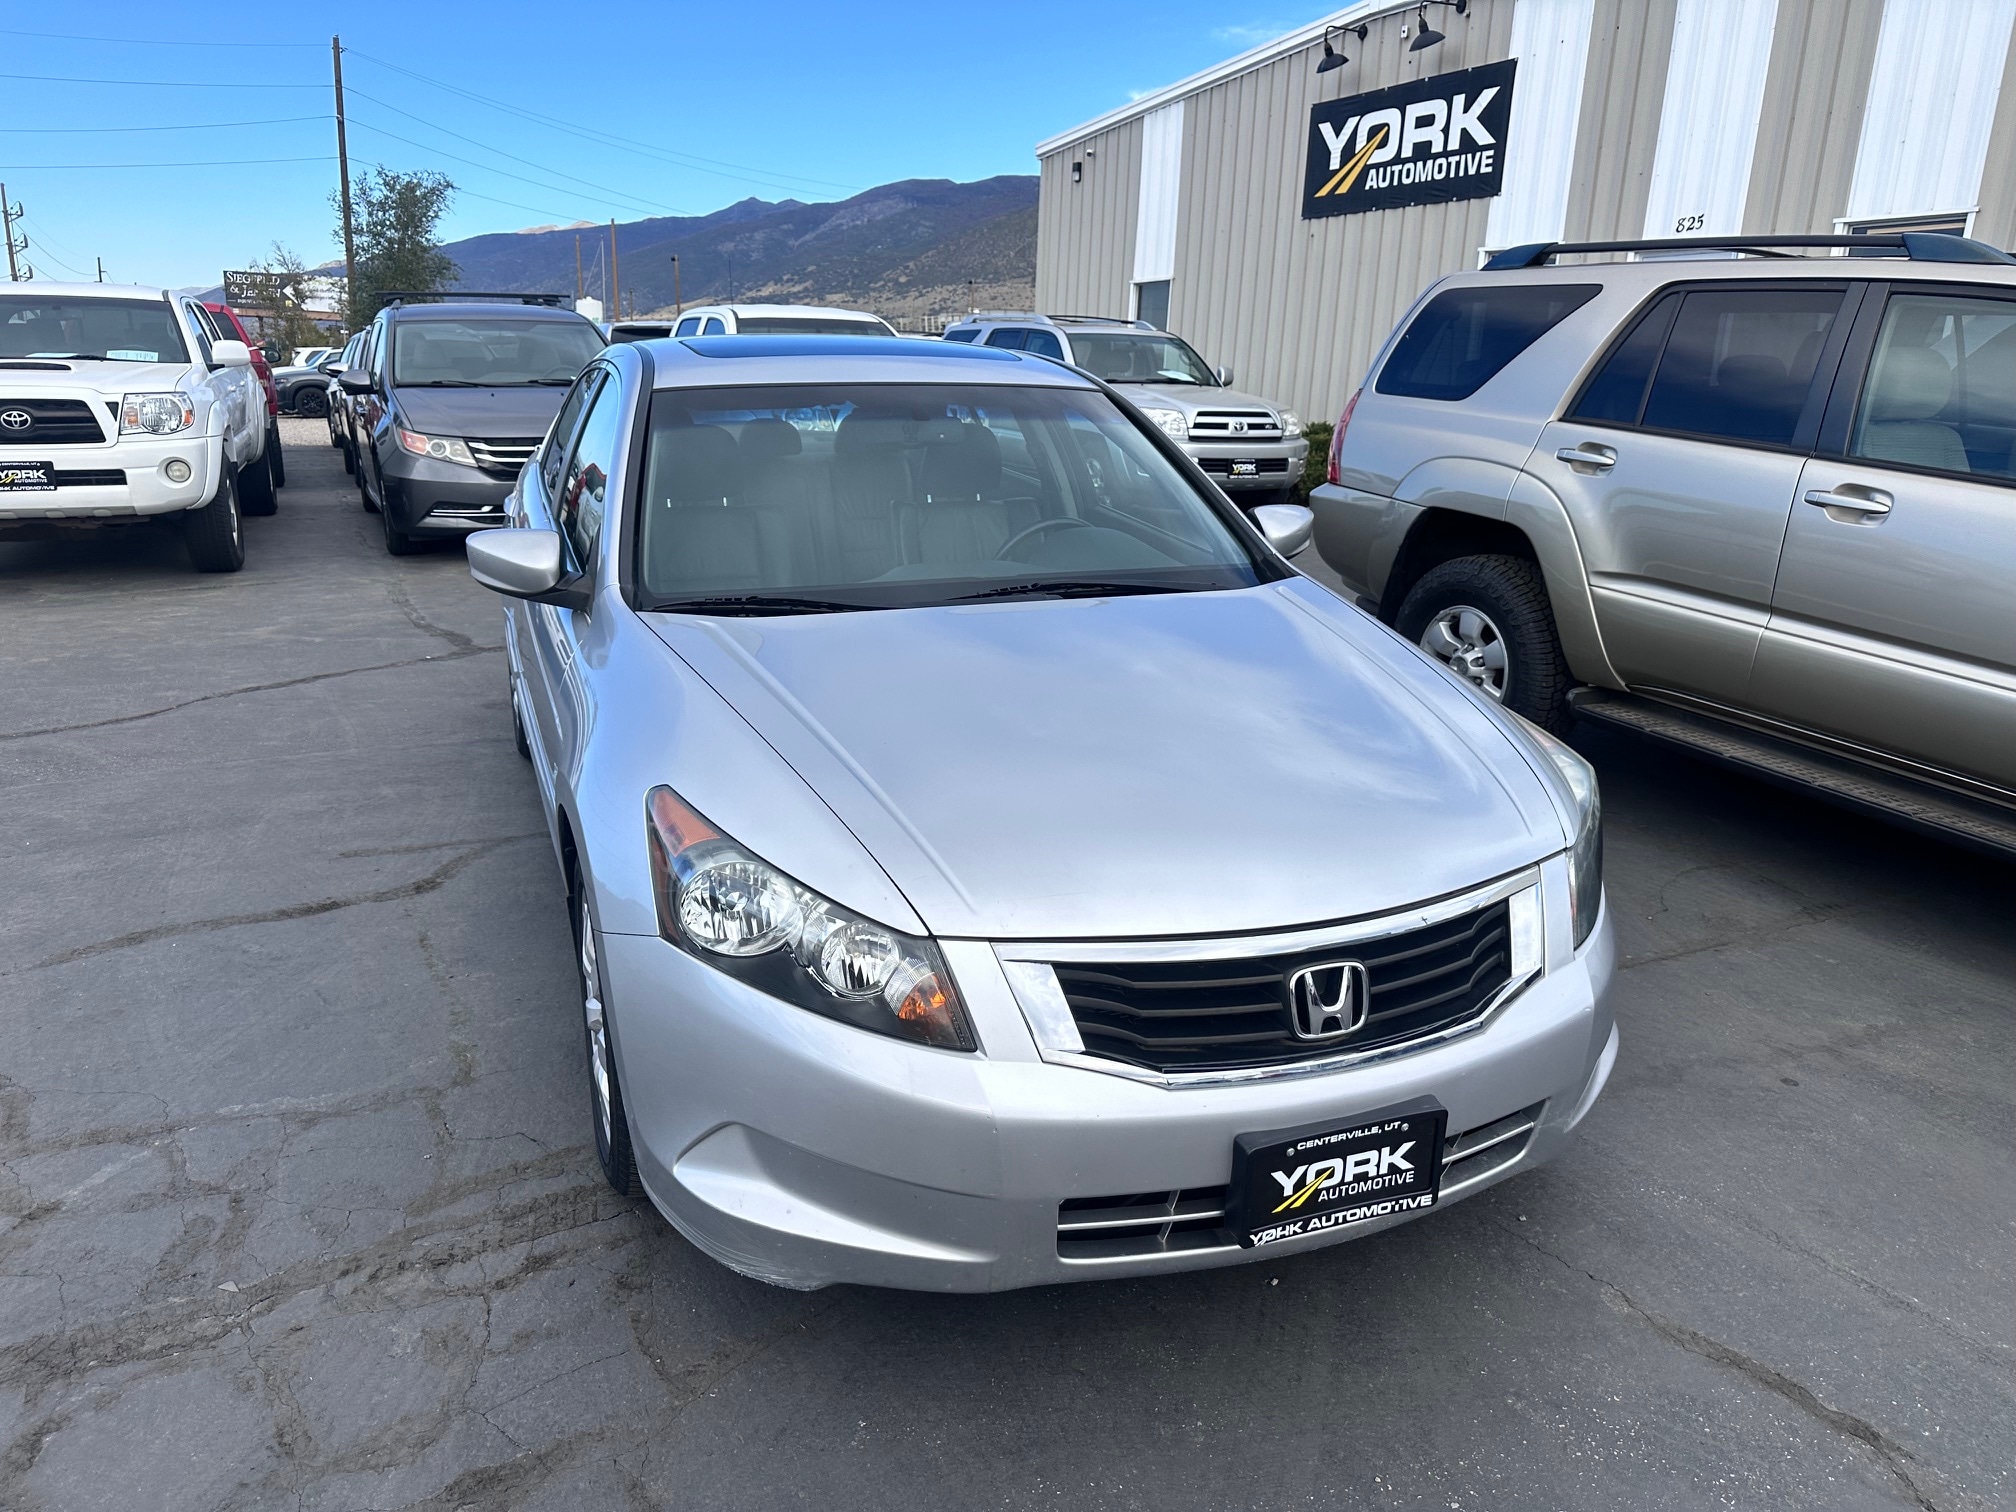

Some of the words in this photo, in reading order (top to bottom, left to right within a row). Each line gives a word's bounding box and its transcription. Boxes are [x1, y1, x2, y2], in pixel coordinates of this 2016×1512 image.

[1318, 86, 1501, 171] YORK
[1364, 149, 1495, 190] AUTOMOTIVE
[1675, 213, 1705, 233] 825
[0, 470, 46, 479] YORK
[1296, 1125, 1382, 1150] CENTERVILLE,
[1384, 1121, 1402, 1131] UT
[1271, 1140, 1417, 1197] YORK
[1318, 1170, 1415, 1202] AUTOMOTIVE
[1307, 1193, 1433, 1231] AUTOMOTIVE
